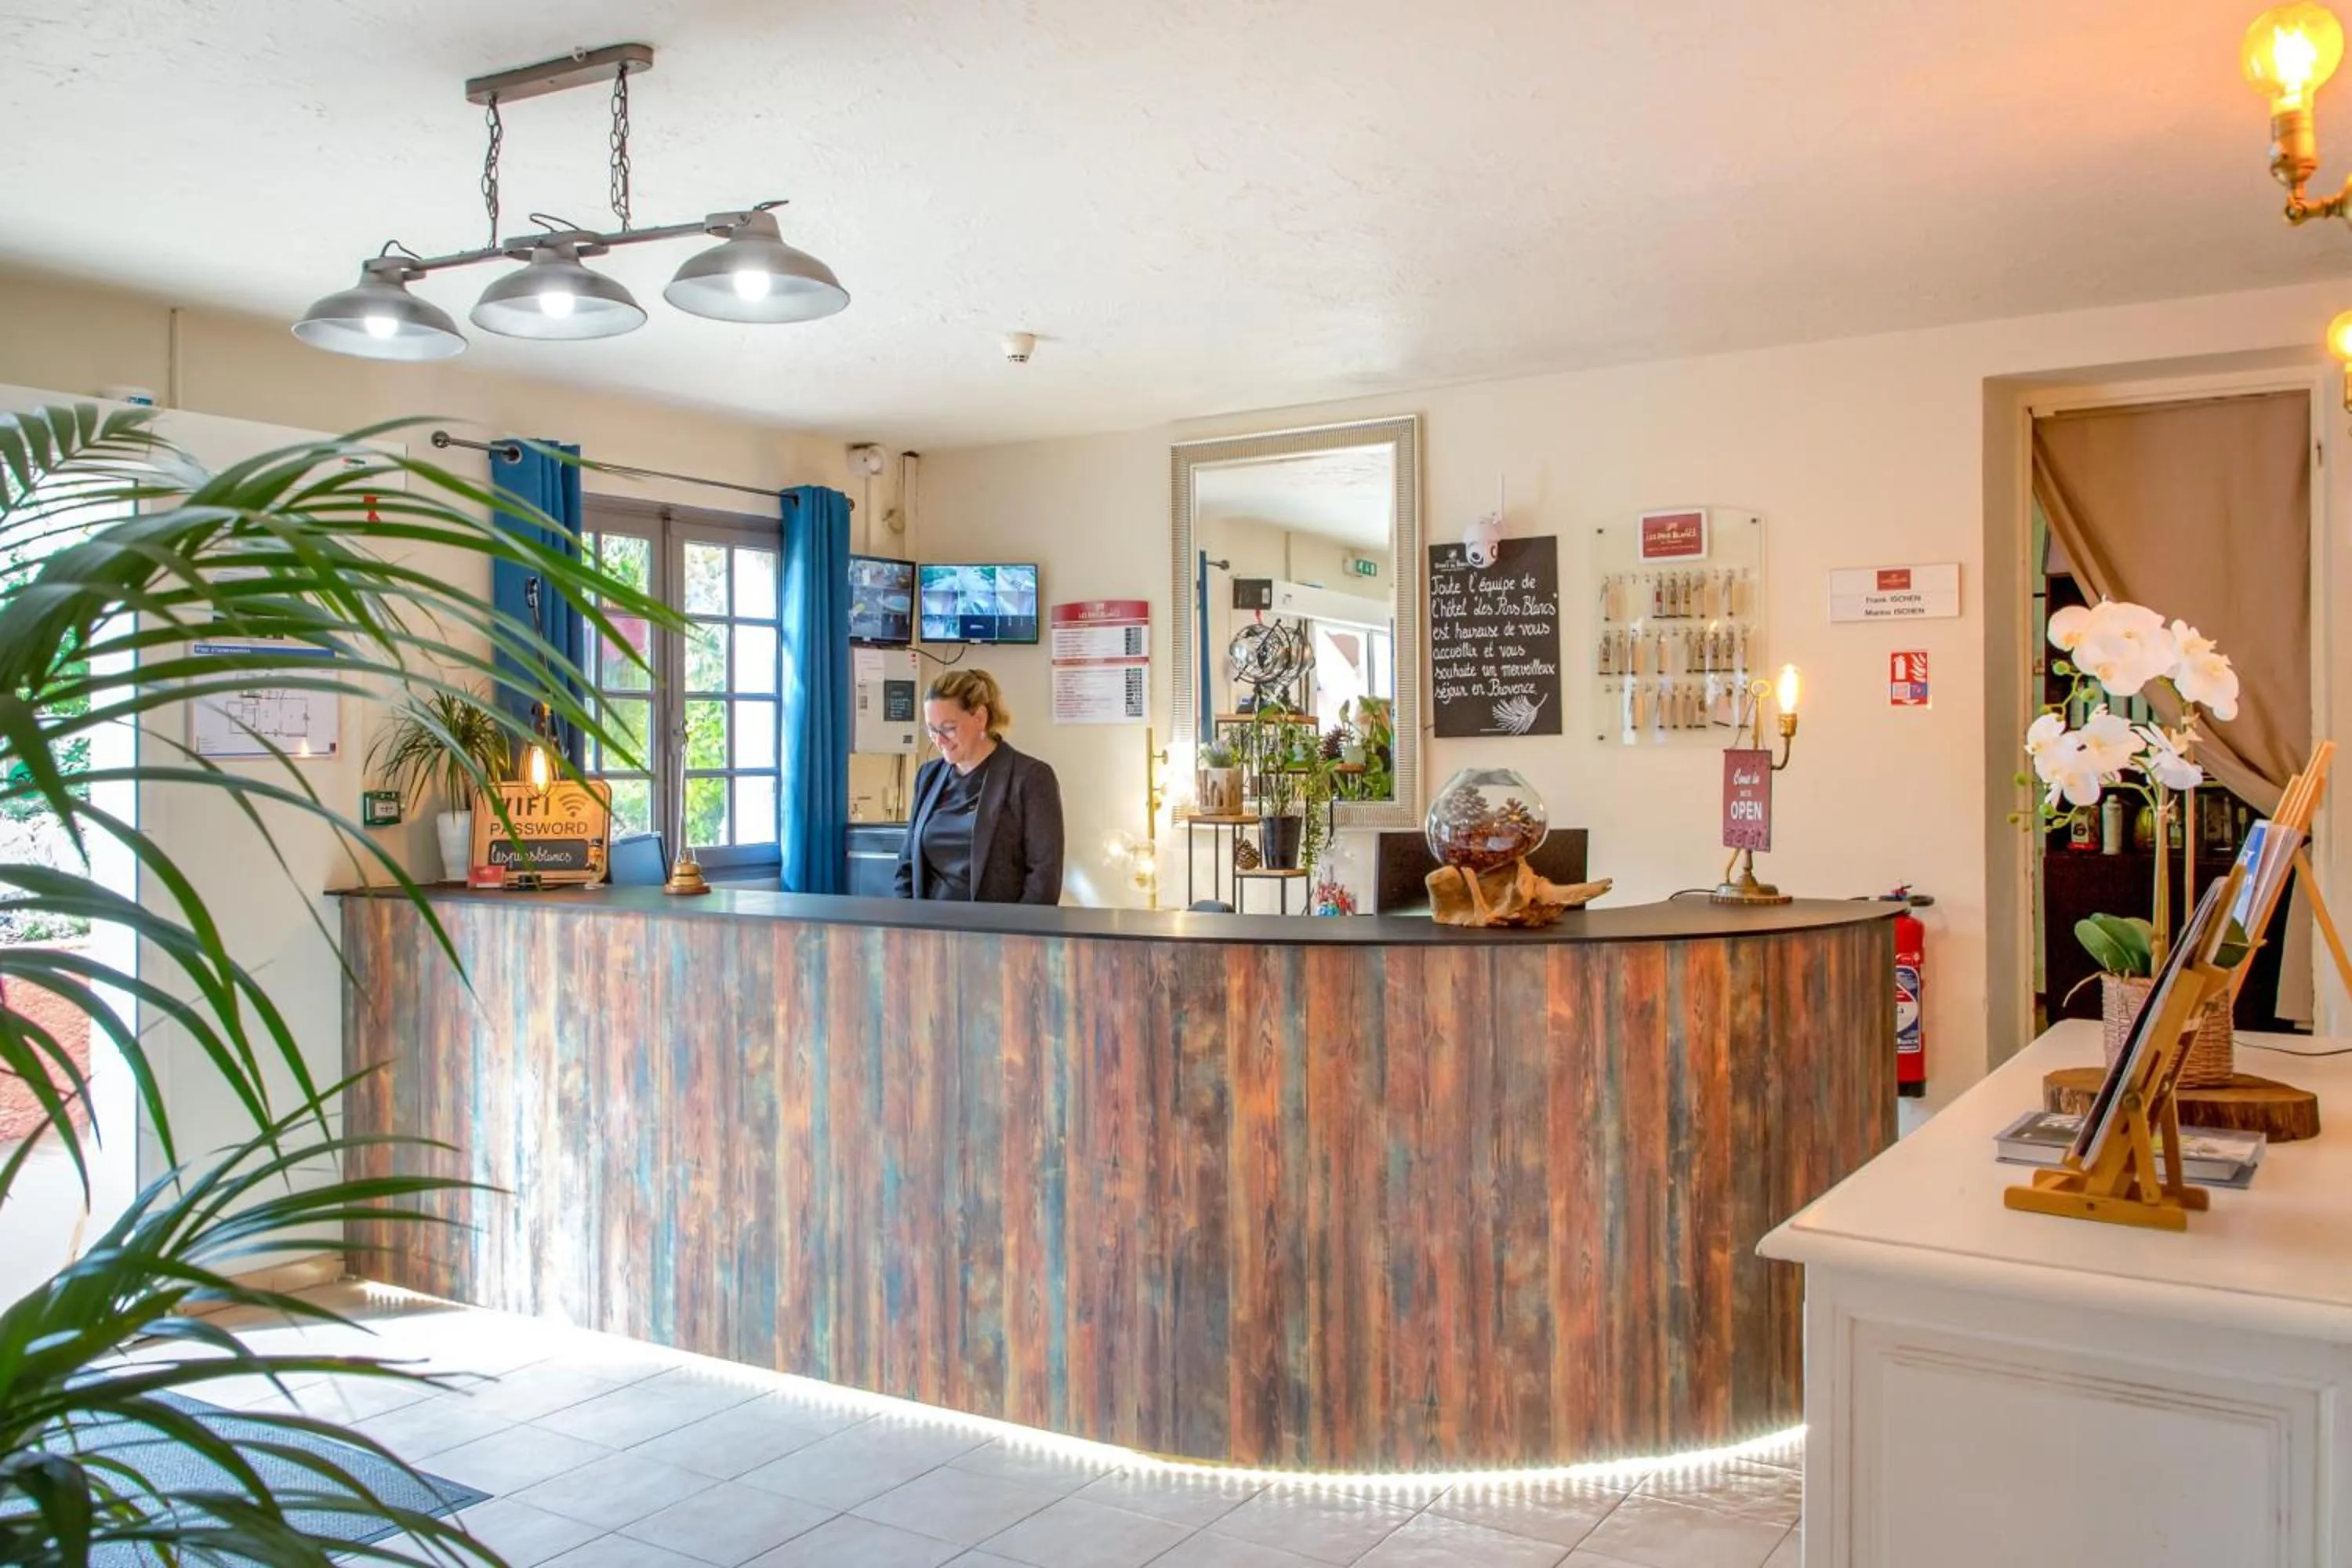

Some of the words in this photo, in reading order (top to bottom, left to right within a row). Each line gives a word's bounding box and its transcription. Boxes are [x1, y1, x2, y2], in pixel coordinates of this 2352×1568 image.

[1431, 575, 1461, 595] Toute
[1521, 572, 1537, 589] de
[1431, 597, 1467, 618] l'hôtel
[1494, 596, 1520, 615] Pins
[1433, 622, 1450, 640] est
[1504, 621, 1515, 637] de
[1519, 622, 1550, 636] vous
[1483, 641, 1494, 658] et
[1498, 644, 1526, 657] vous
[1434, 662, 1477, 680] souhaite
[1482, 664, 1498, 677] un
[1472, 683, 1486, 695] en
[1487, 678, 1537, 696] Provence
[1730, 800, 1762, 821] OPEN
